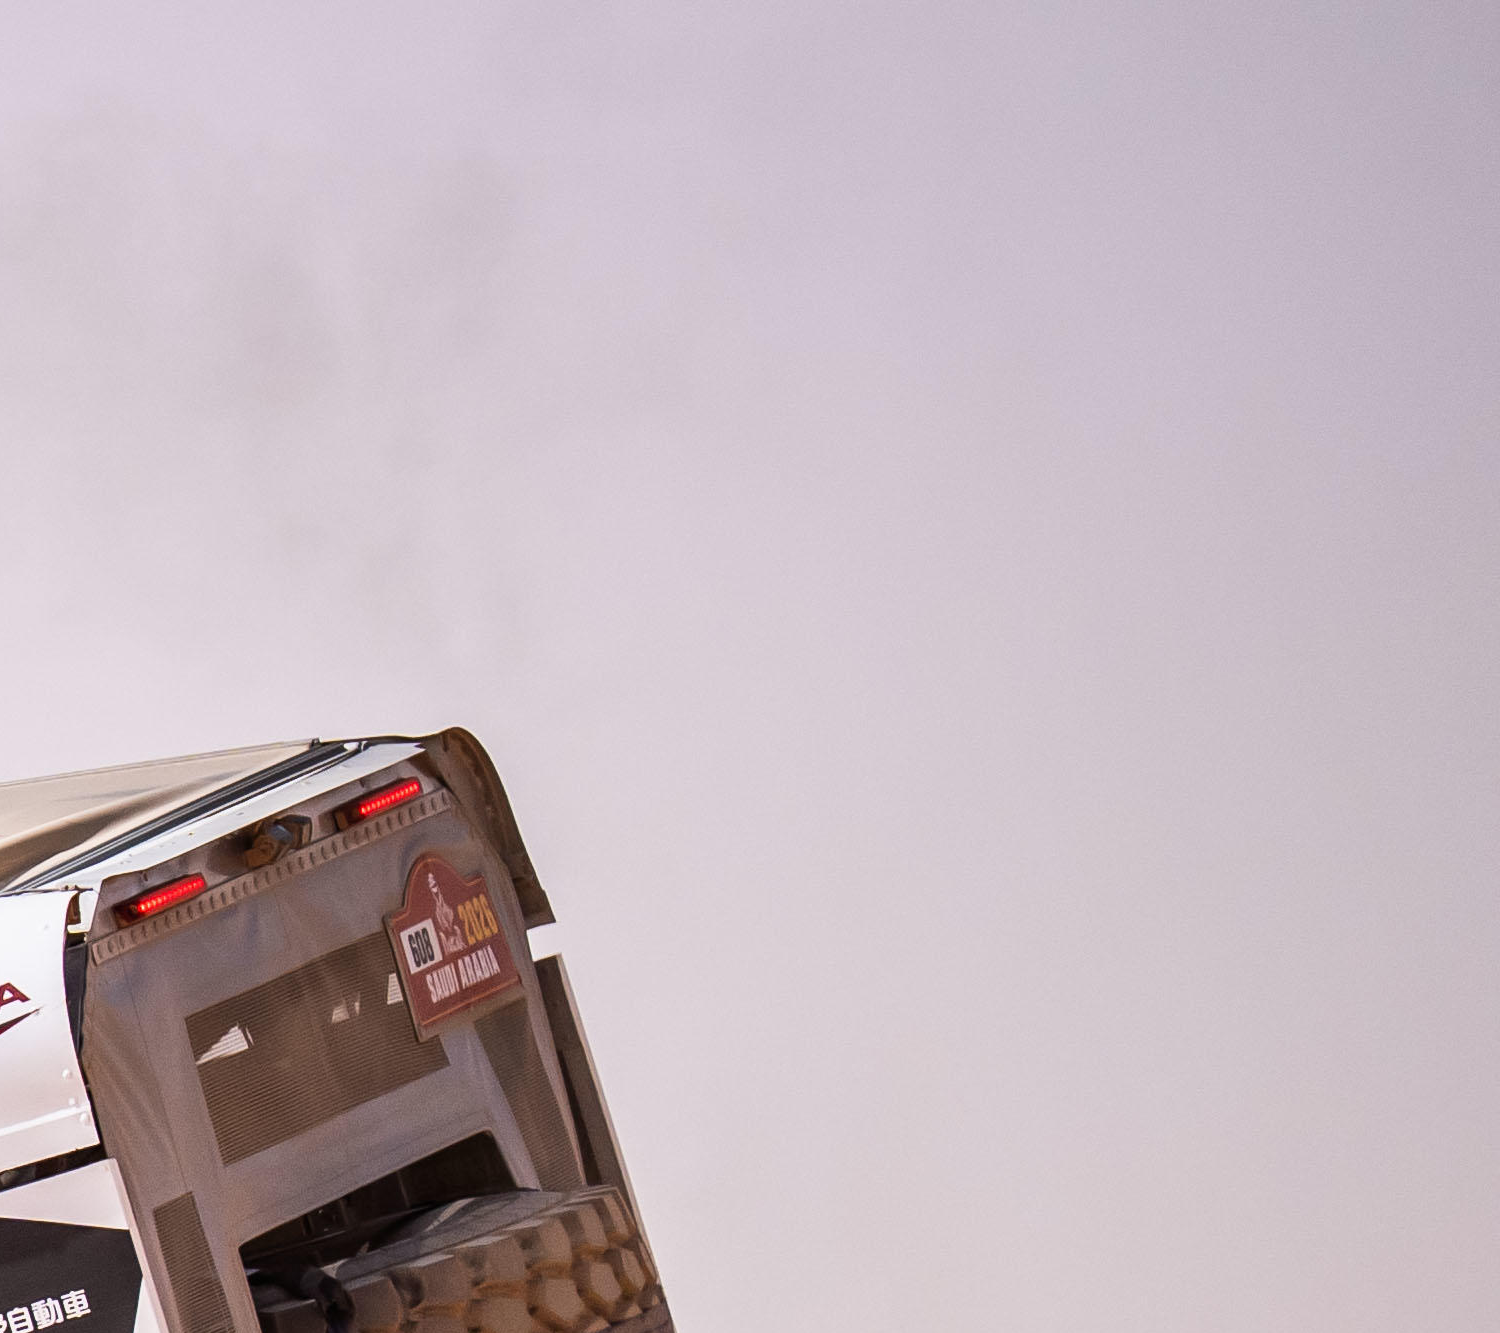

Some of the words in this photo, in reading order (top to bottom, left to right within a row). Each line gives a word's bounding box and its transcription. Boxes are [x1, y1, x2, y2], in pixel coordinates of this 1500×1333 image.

[457, 894, 498, 944] 2026
[407, 927, 436, 968] 608
[425, 965, 459, 1004] SAUDI
[457, 945, 500, 988] ARABIA
